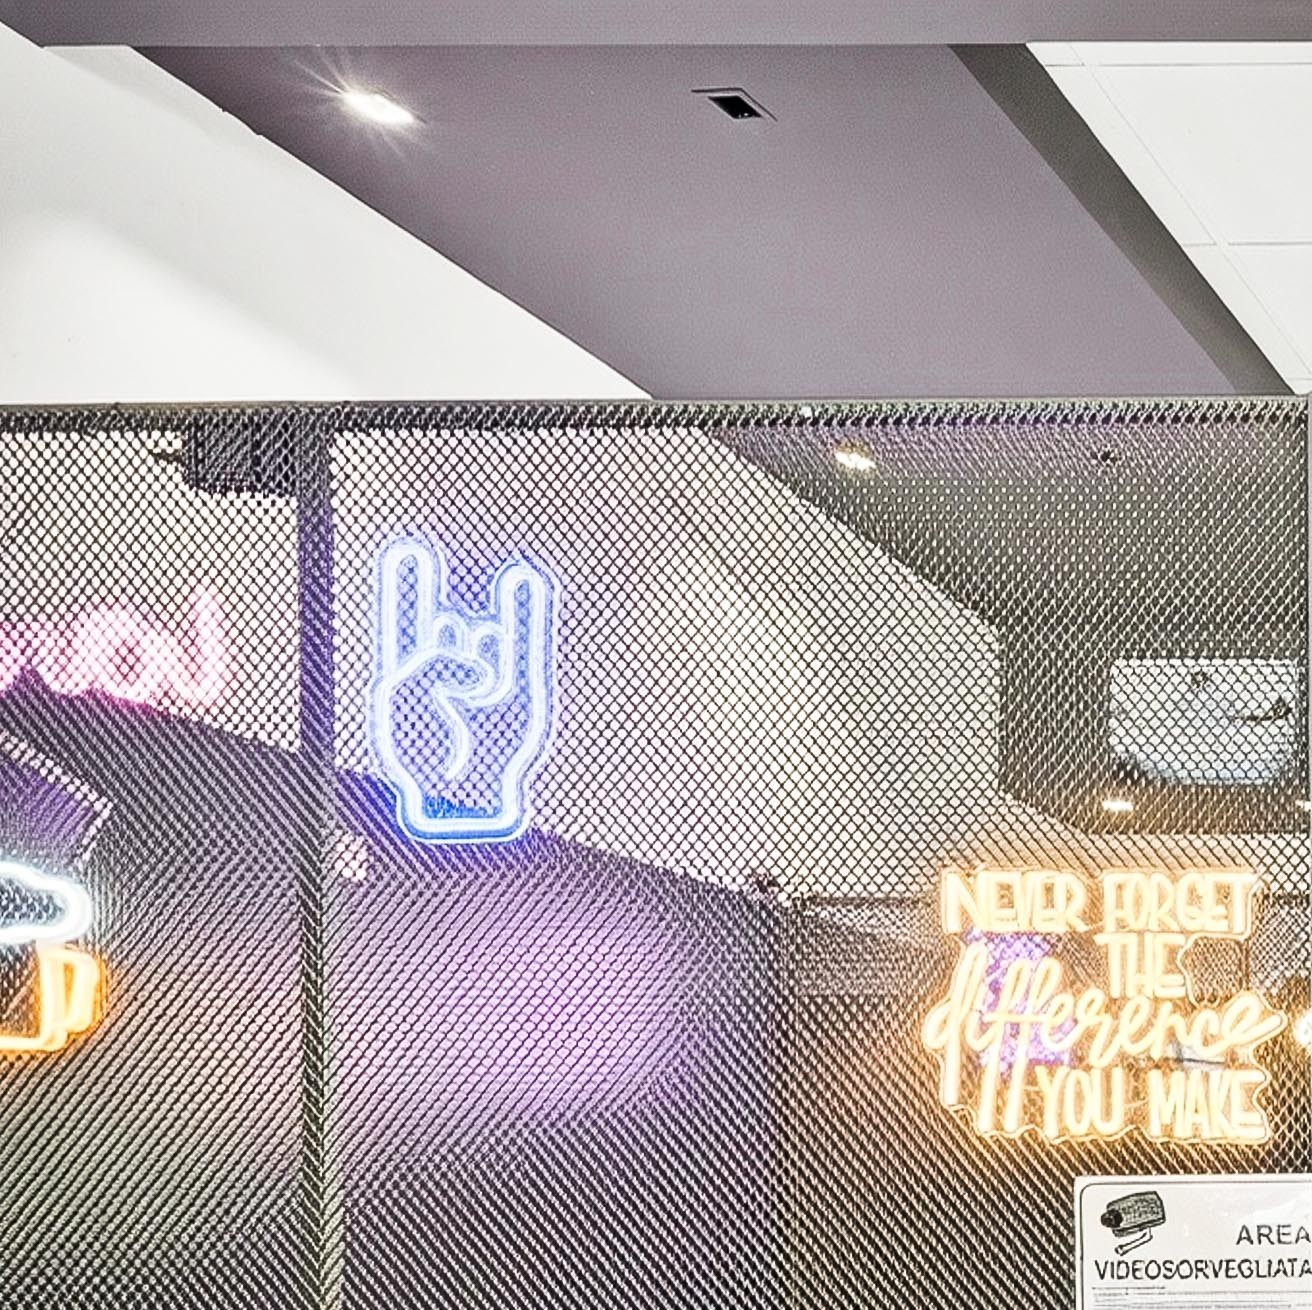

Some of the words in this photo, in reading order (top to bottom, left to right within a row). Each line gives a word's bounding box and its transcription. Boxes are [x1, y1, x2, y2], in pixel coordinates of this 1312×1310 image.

[942, 870, 1090, 934] NEVER
[1102, 870, 1257, 934] FORGET
[1095, 931, 1187, 999] THE
[922, 940, 1287, 1134] difference
[1034, 1064, 1126, 1138] YOU
[1147, 1067, 1268, 1140] MAKE
[1235, 1223, 1312, 1246] AREA
[1093, 1257, 1312, 1280] VIDEOSORVEGLIATA
